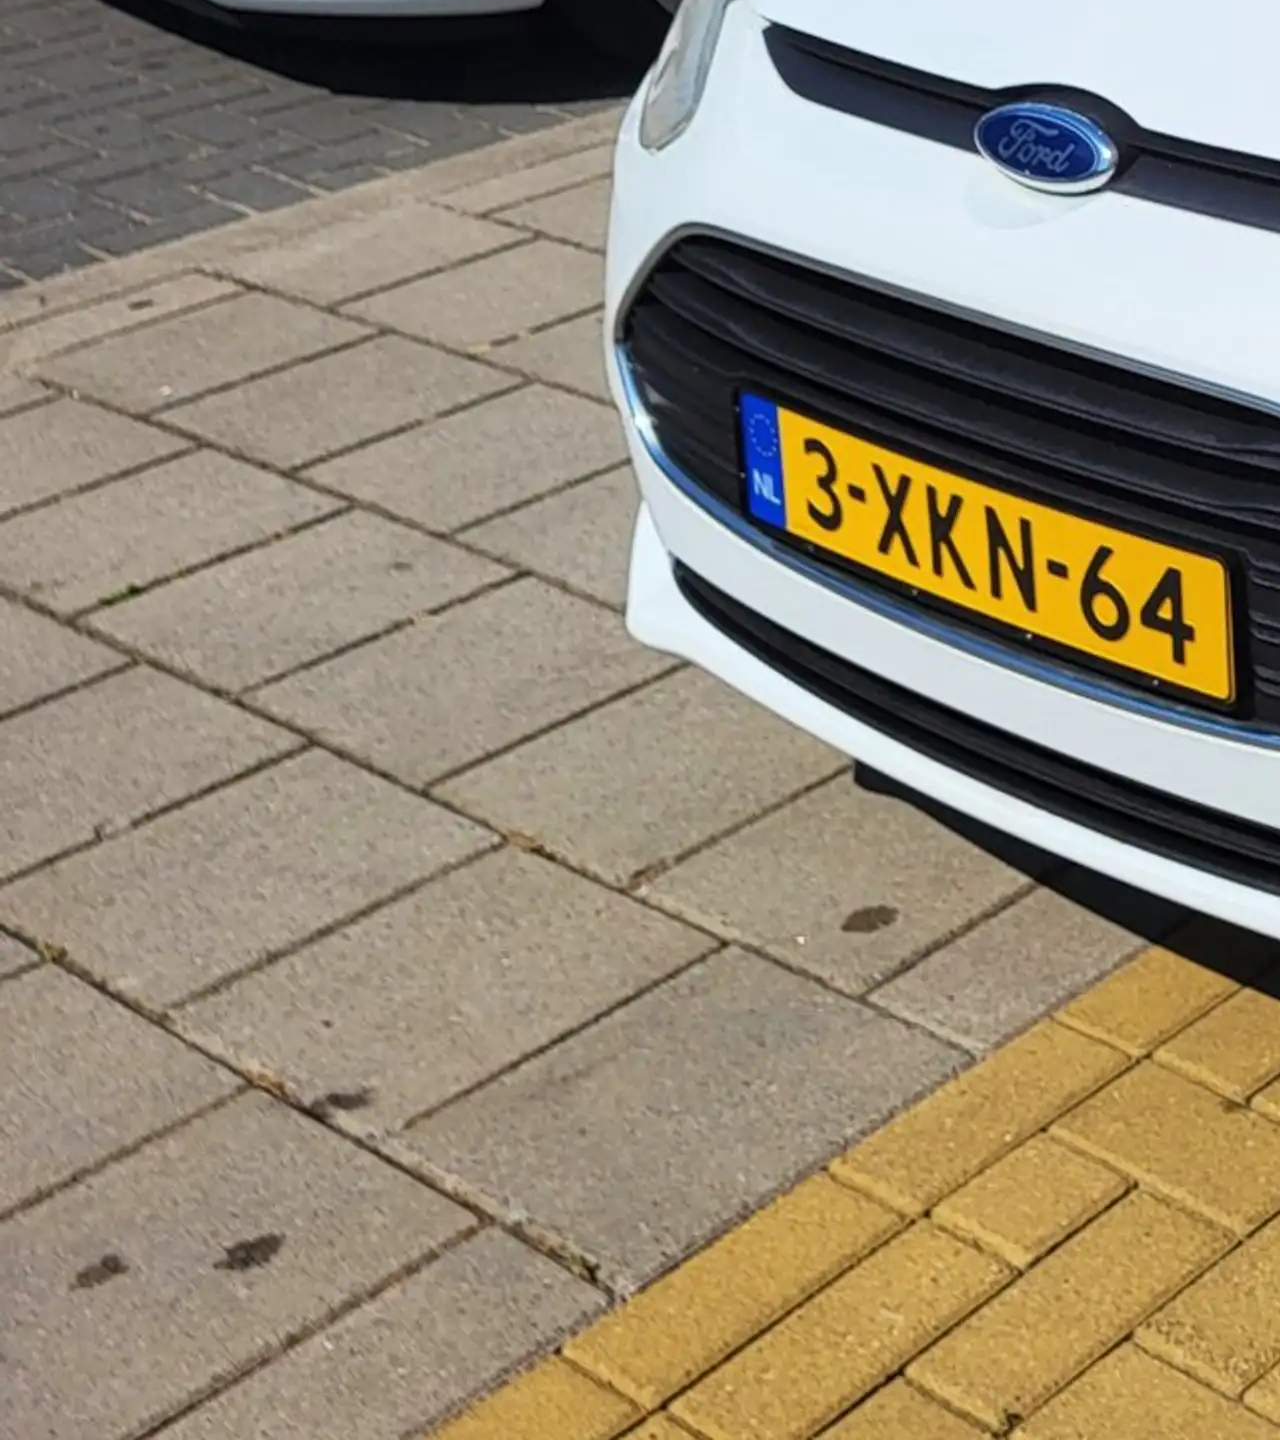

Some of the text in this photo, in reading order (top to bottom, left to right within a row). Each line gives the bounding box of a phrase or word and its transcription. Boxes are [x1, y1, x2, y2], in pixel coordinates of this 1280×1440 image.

[998, 118, 1075, 173] Ford
[752, 467, 781, 506] NL
[803, 438, 1196, 666] 3-XKN-64
